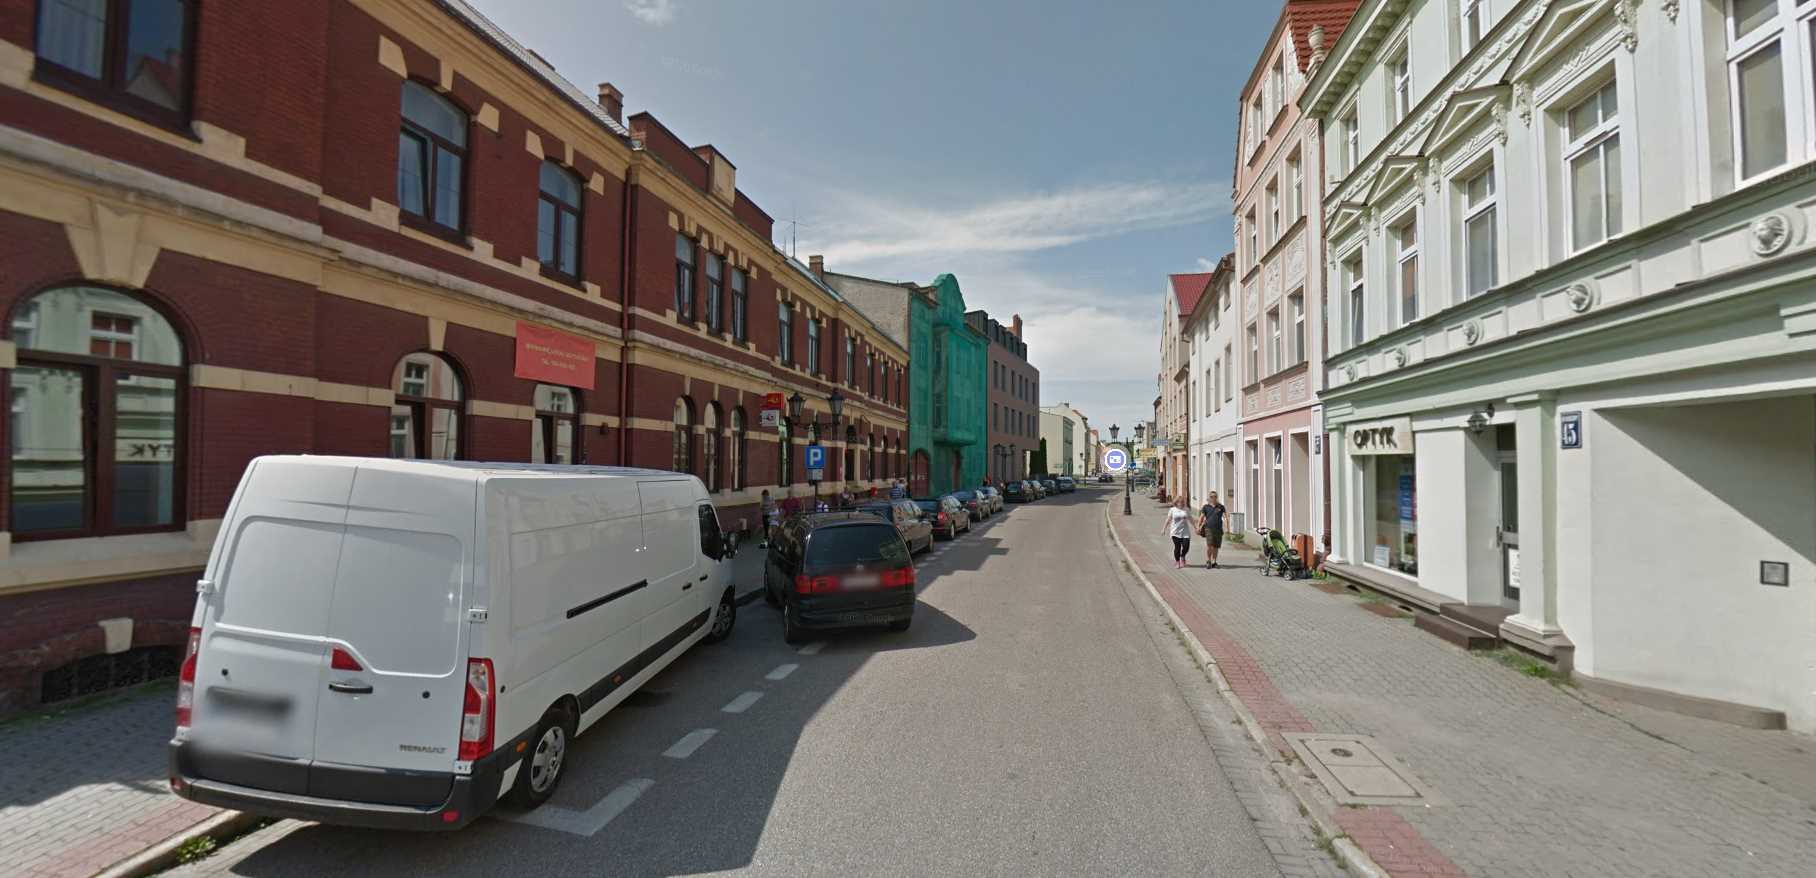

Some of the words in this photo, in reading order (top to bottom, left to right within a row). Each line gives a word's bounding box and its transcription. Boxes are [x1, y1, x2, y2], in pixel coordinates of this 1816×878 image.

[1353, 426, 1398, 449] OPTYK
[1563, 423, 1577, 445] 15
[809, 448, 822, 466] P
[399, 744, 447, 754] RENAULT
